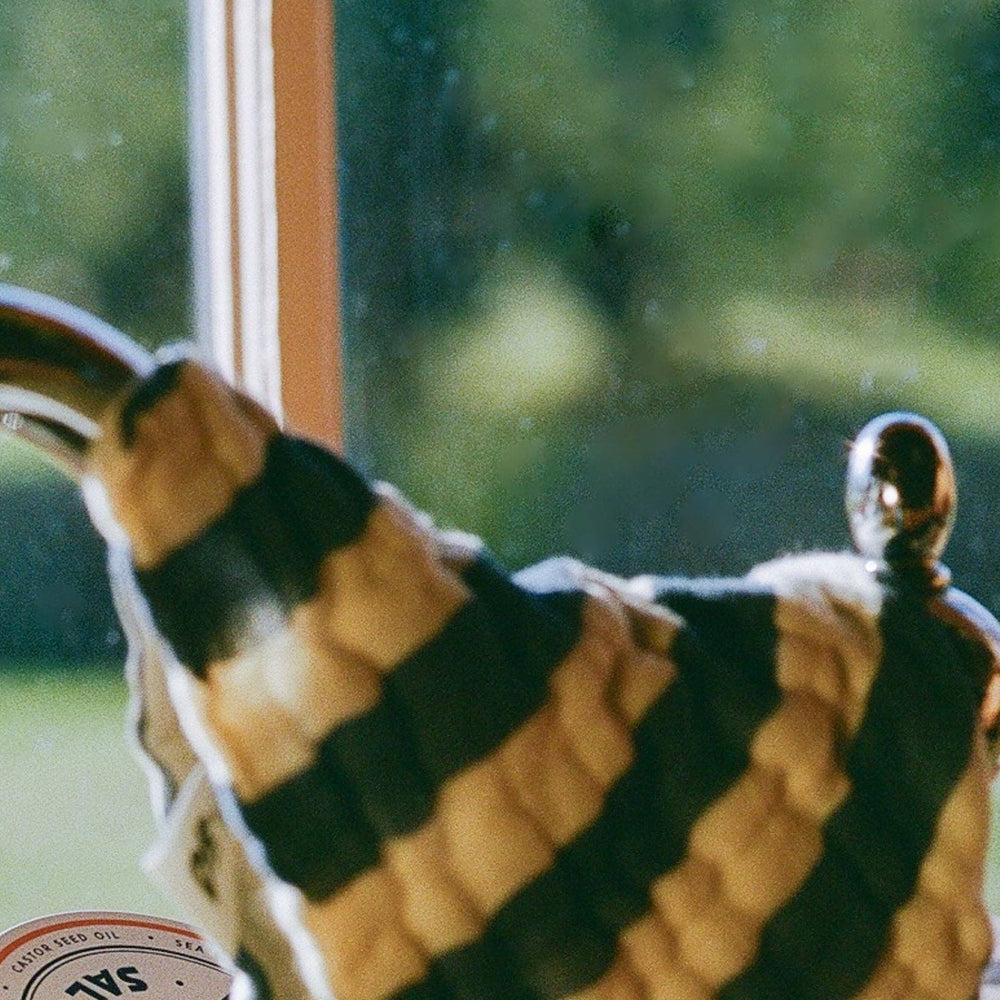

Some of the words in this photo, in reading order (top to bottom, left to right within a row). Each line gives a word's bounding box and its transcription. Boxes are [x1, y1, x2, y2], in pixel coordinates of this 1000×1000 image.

[11, 939, 54, 973] CASTOR
[55, 931, 88, 948] SEED
[94, 930, 120, 941] OIL
